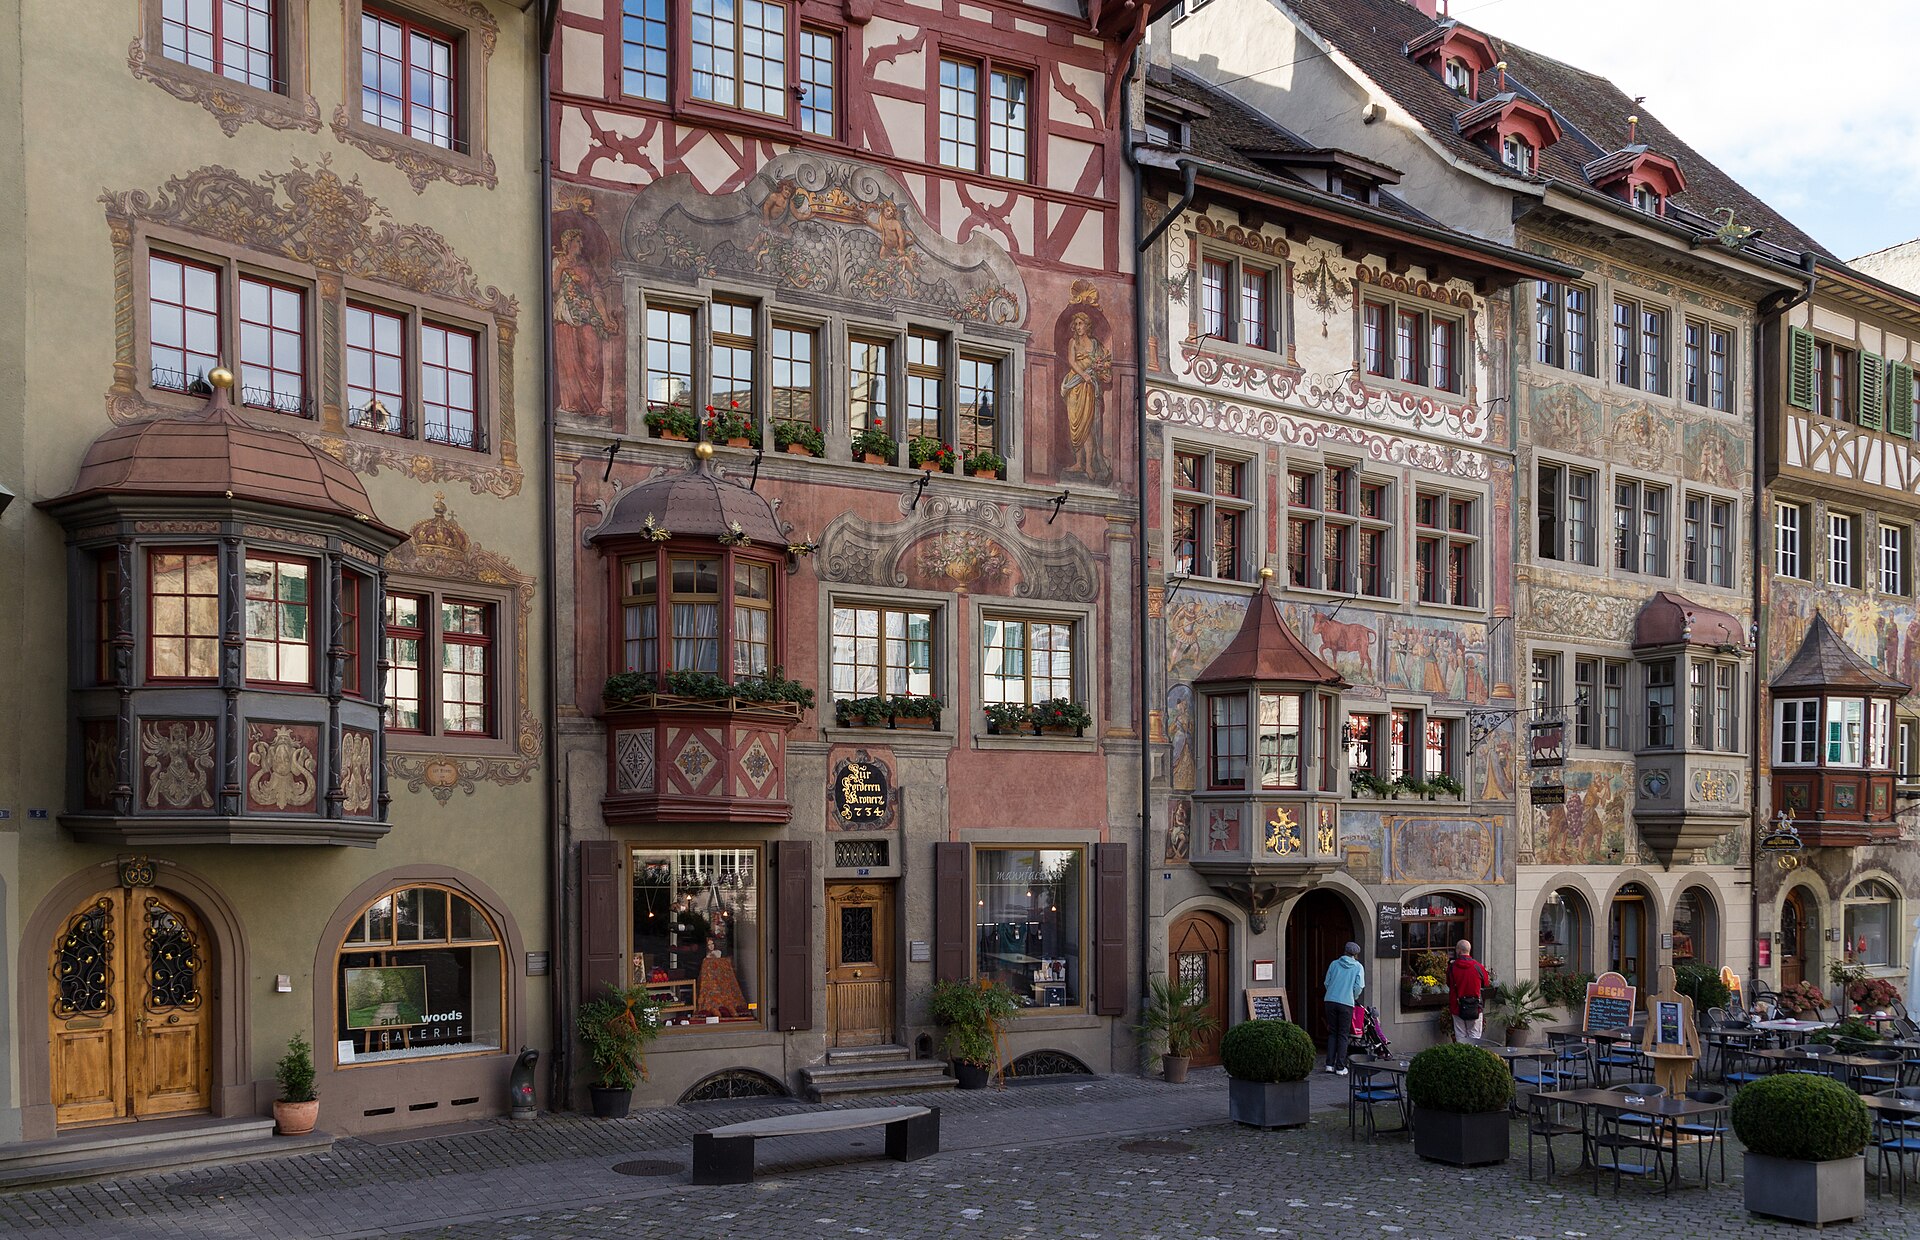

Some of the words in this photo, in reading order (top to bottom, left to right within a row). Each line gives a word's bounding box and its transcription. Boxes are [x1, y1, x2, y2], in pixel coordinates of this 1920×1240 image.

[841, 803, 885, 820] 1734
[1597, 986, 1625, 997] BECK
[421, 1010, 463, 1023] woods
[380, 1026, 463, 1043] GALERIE
